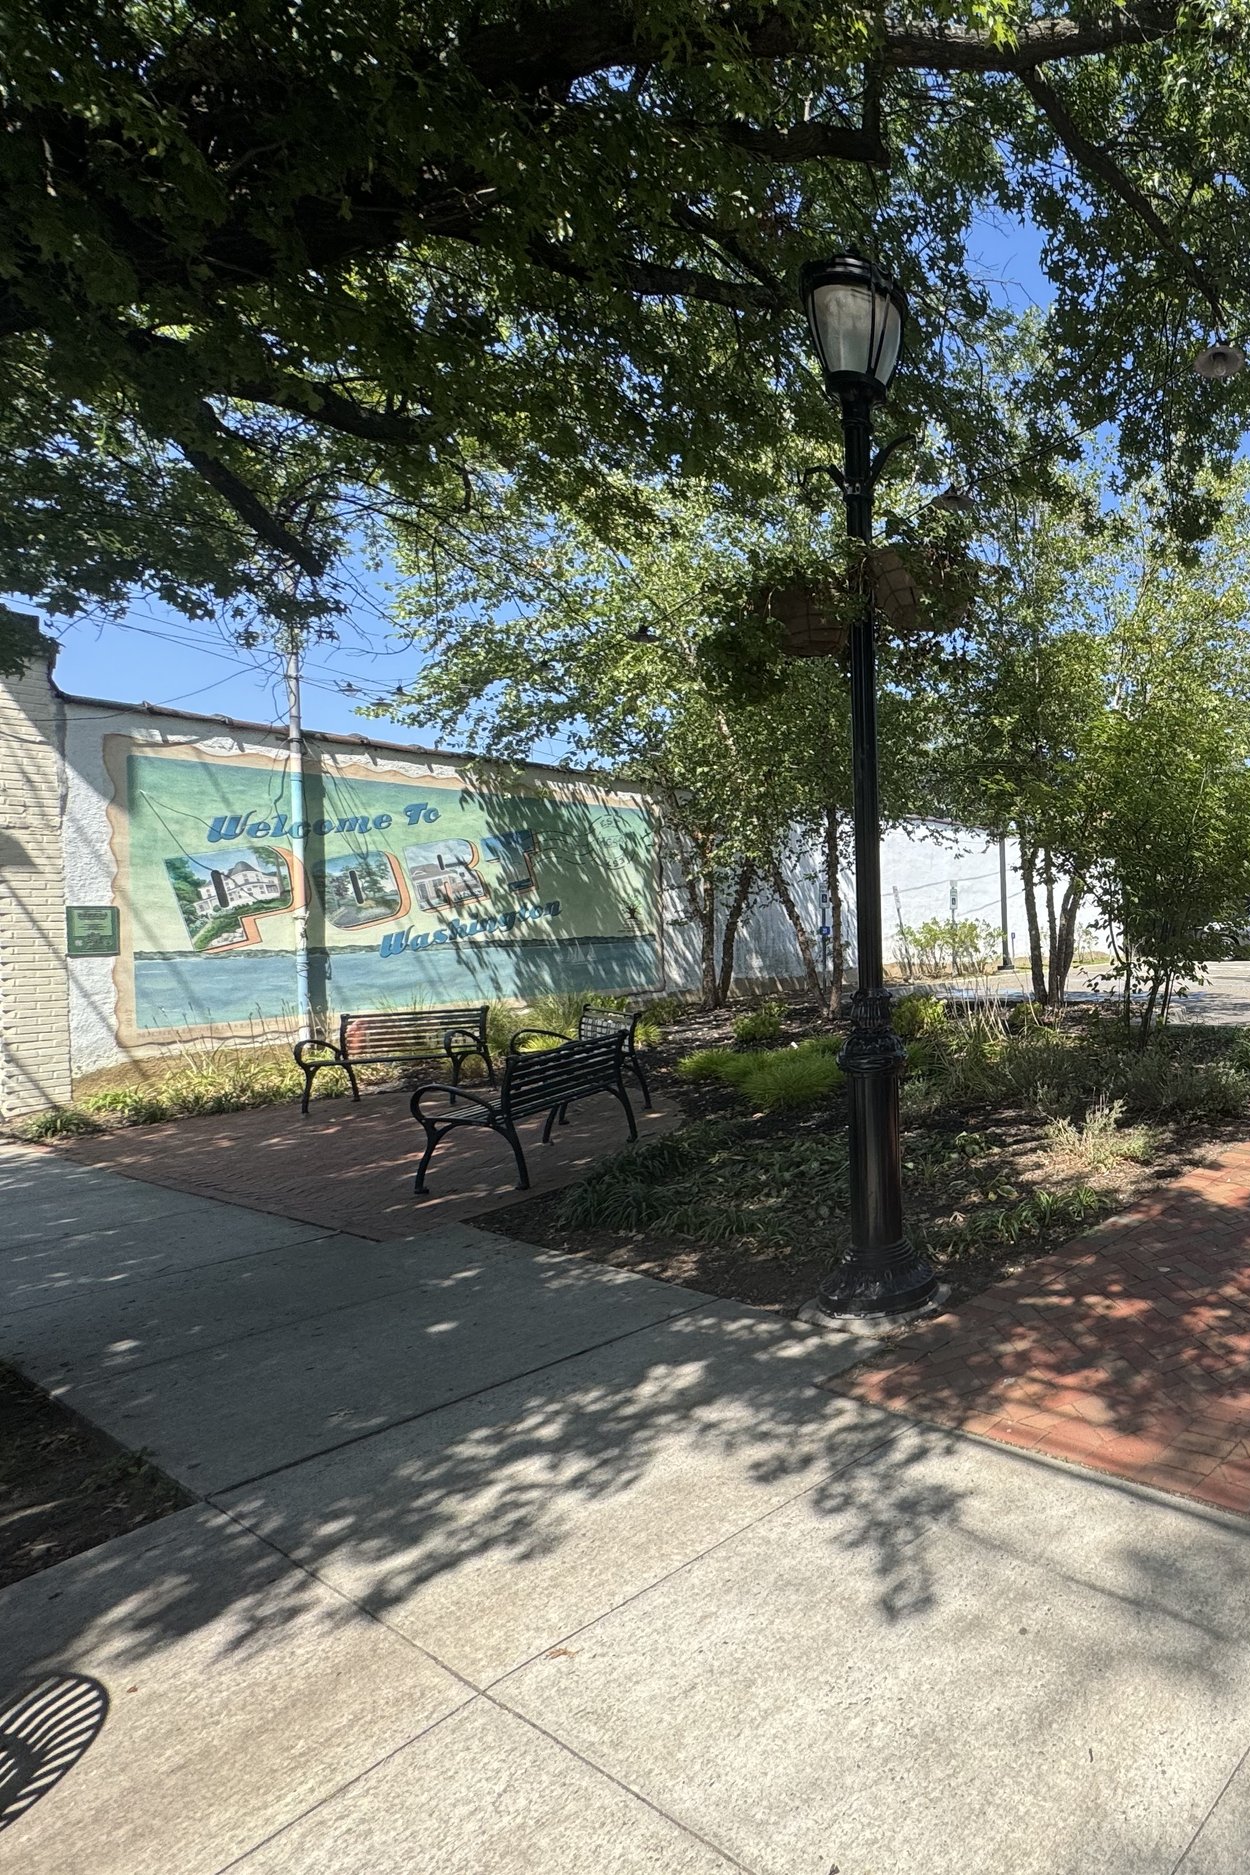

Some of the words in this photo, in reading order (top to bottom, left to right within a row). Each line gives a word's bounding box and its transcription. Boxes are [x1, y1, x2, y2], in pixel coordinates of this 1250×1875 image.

[207, 810, 392, 843] Welcome
[403, 803, 441, 825] To
[164, 829, 540, 954] PORT
[380, 900, 562, 958] Washington
